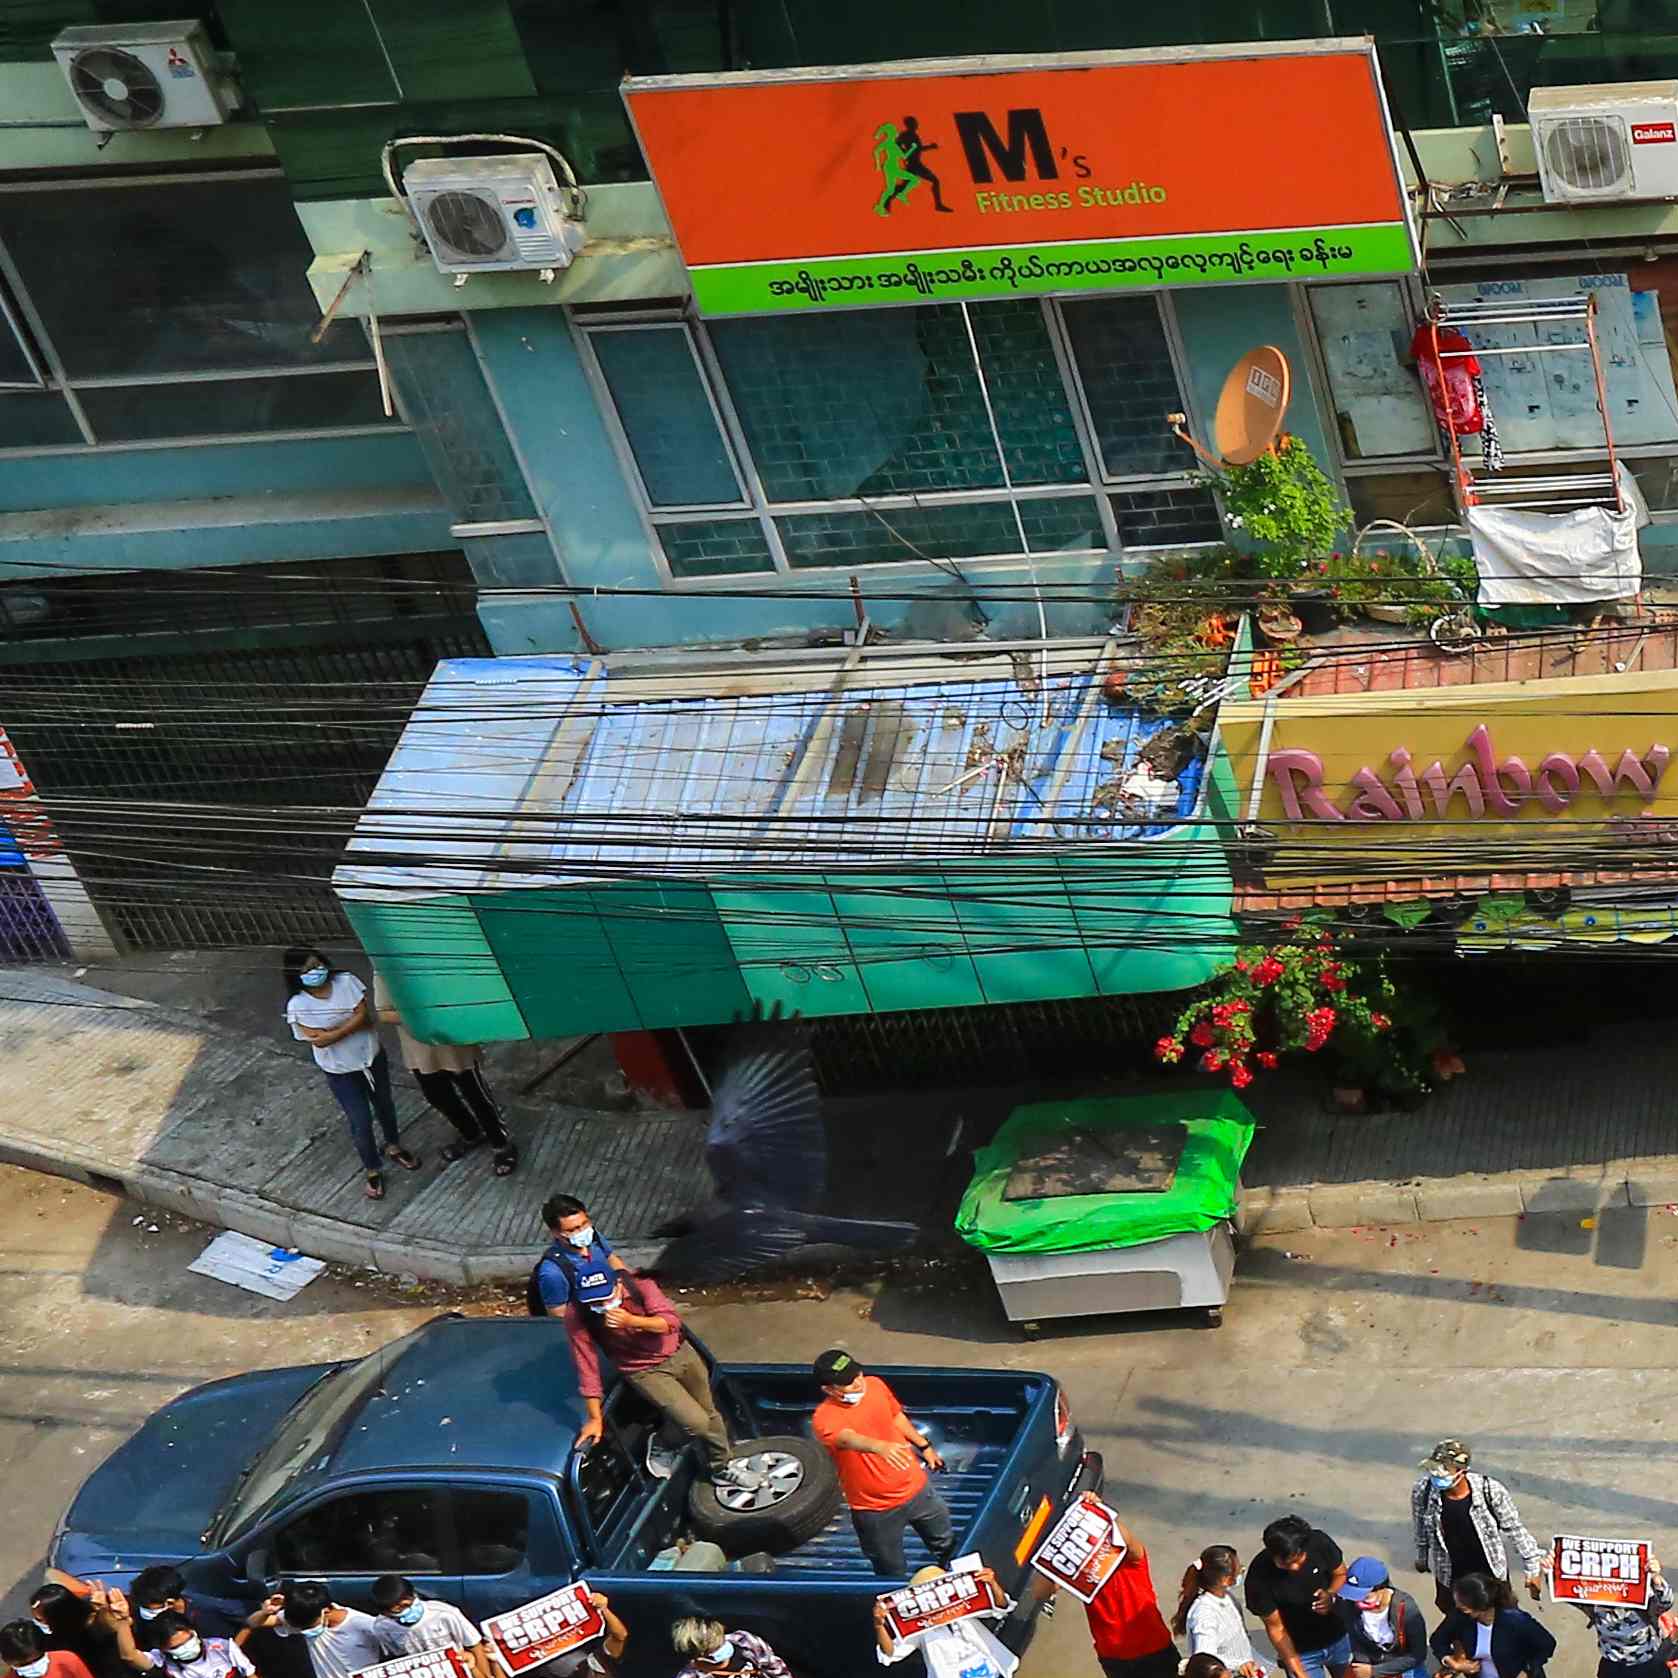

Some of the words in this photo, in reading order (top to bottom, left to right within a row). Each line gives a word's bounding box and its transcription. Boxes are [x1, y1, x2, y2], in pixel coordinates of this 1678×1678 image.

[954, 108, 1092, 184] M's
[1634, 127, 1674, 141] Galanz
[975, 191, 1072, 214] Fitness
[1078, 181, 1167, 208] Studio
[769, 269, 875, 302] အမျိုးသား
[878, 259, 986, 295] အမျိုးသမီး
[1268, 723, 1670, 832] Rainbow
[1061, 1505, 1110, 1577] CRPH
[1563, 1540, 1580, 1553] WE
[1583, 1541, 1637, 1554] SUPPORT
[1561, 1551, 1639, 1580] CRPH
[500, 1612, 521, 1630] WE
[521, 1591, 576, 1619] SUPPORT
[900, 1576, 976, 1618] CRPH
[504, 1603, 590, 1649] CRPH
[385, 1650, 447, 1674] SUPPORT
